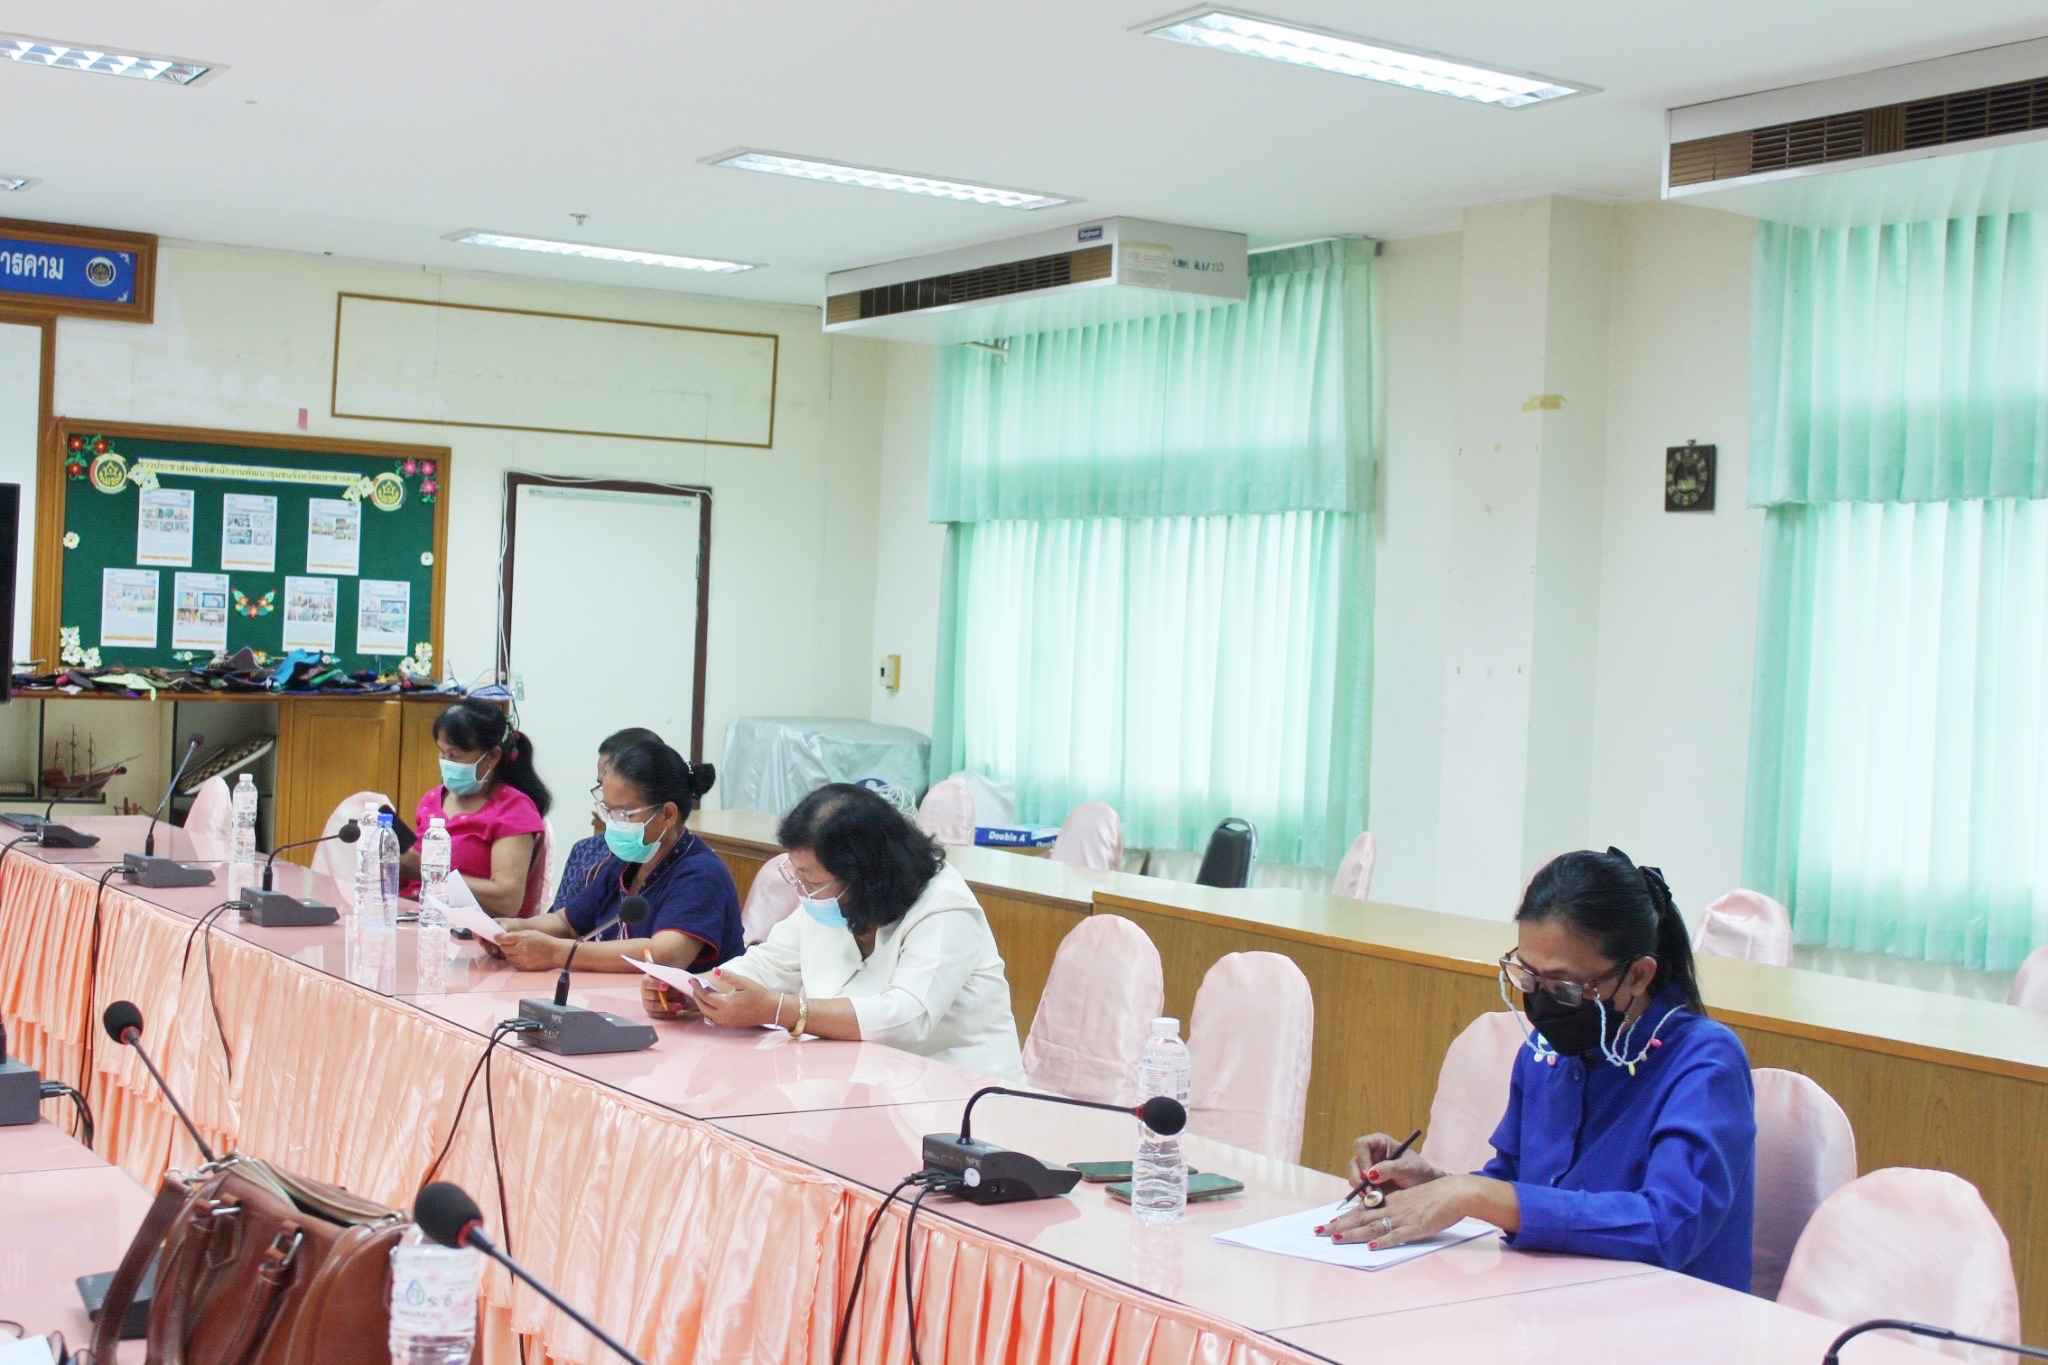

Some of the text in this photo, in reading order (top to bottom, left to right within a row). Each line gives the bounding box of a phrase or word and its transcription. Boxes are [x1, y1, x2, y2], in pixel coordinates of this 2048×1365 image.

[988, 831, 1026, 842] Double A
[965, 1156, 981, 1167] NPE
